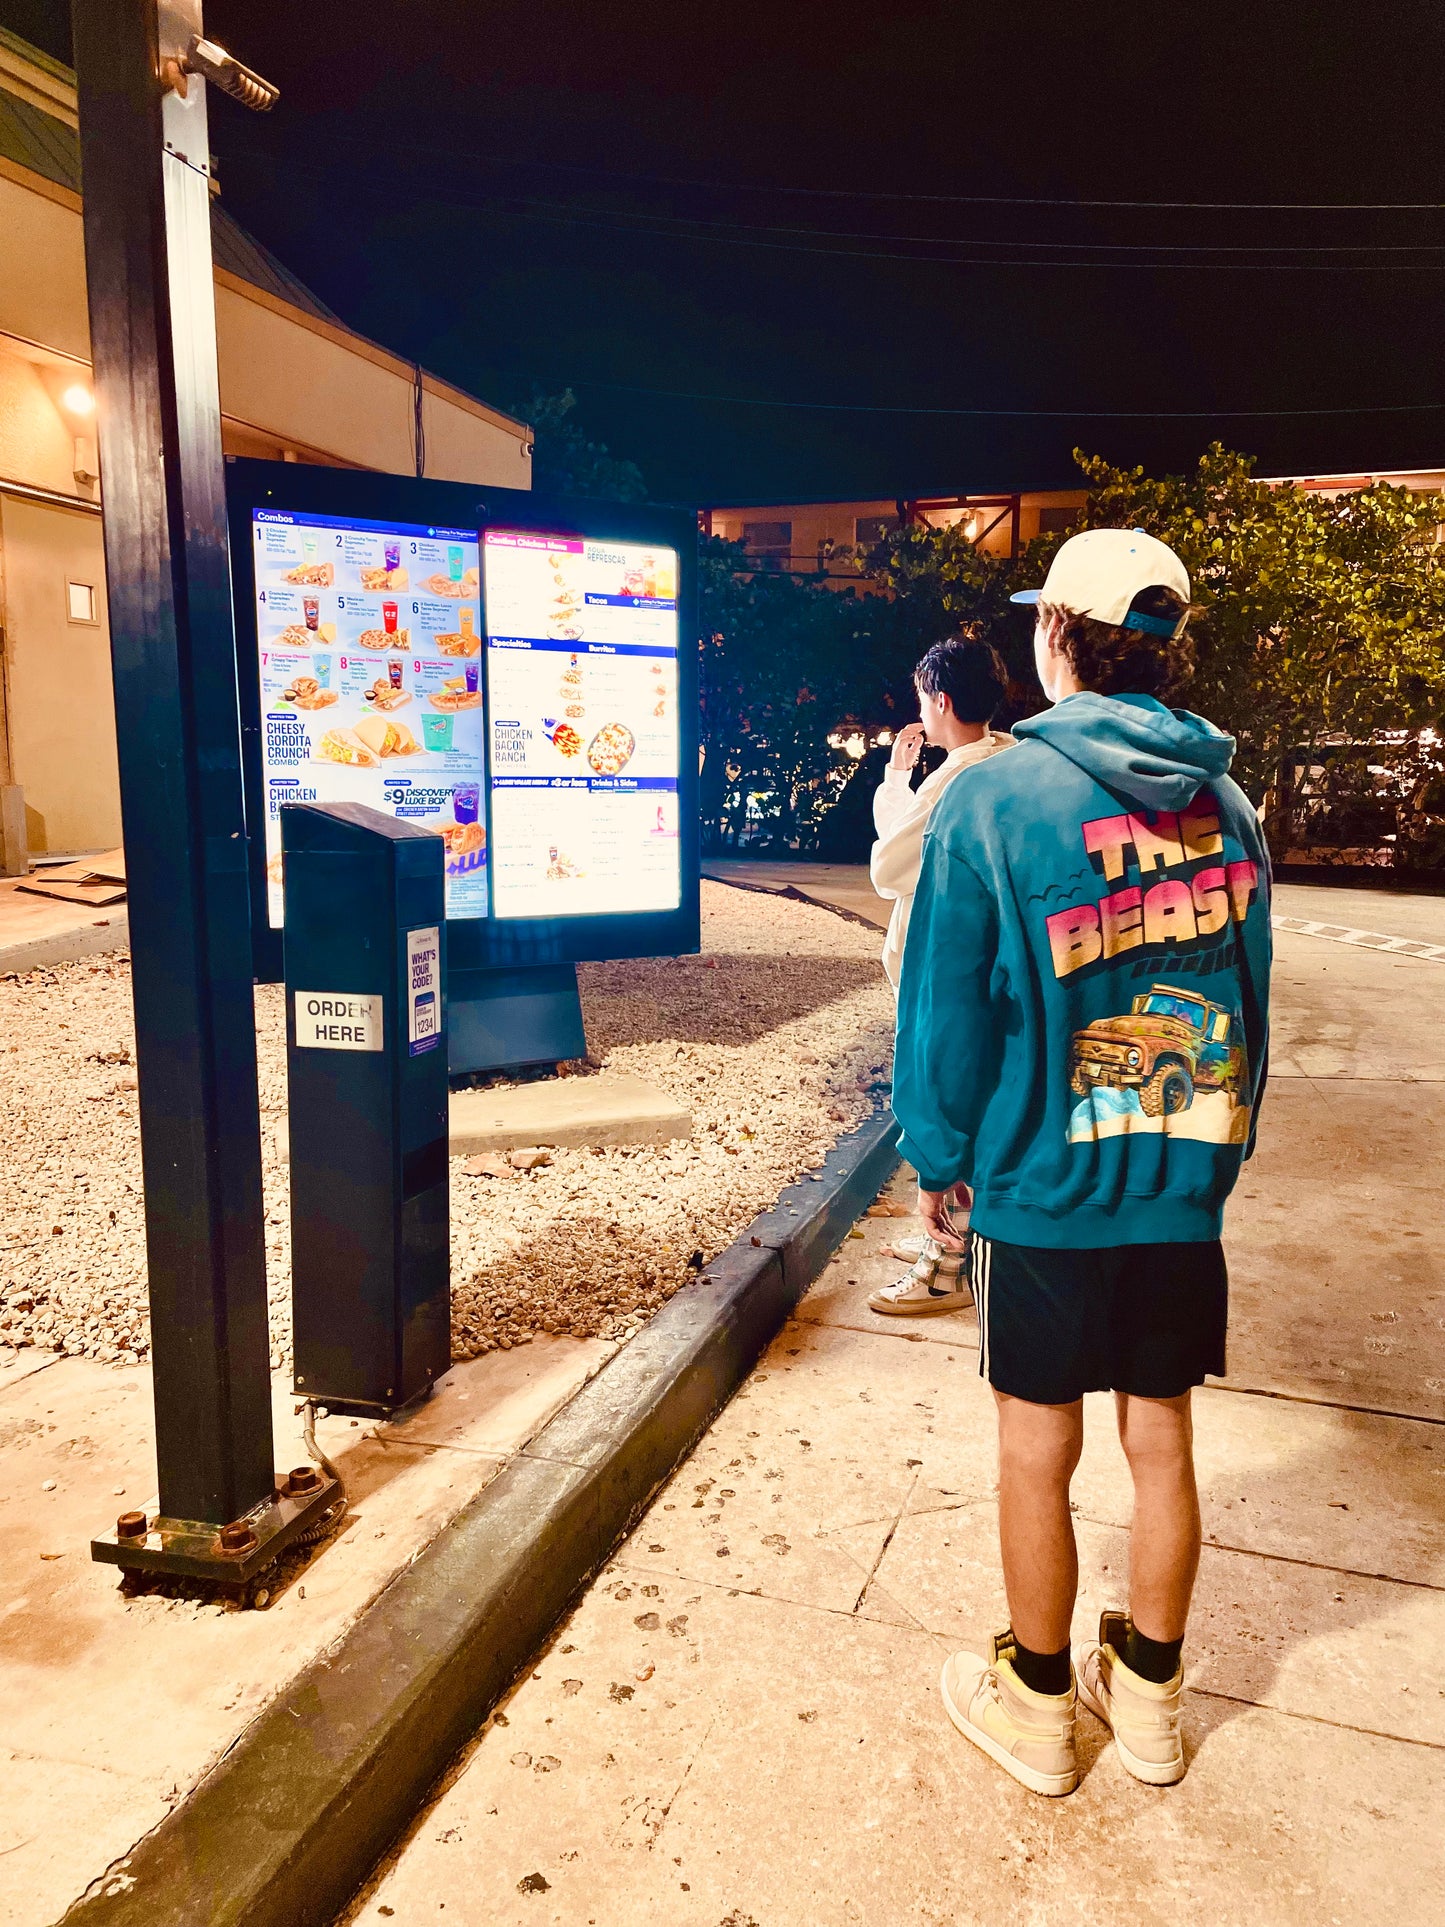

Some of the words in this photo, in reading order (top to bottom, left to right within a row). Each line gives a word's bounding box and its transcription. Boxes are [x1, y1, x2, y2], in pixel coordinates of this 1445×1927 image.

[257, 512, 294, 523] Combos
[257, 527, 262, 540] 1
[335, 535, 343, 548] 2
[410, 542, 417, 554] 3
[587, 553, 625, 565] REFRESCAS
[259, 591, 267, 603] 4
[338, 596, 345, 609] 5
[587, 595, 607, 605] Tacos
[412, 601, 419, 614] 6
[492, 638, 532, 649] Specialties
[588, 644, 616, 653] Burritos
[262, 653, 268, 665] 7
[340, 657, 347, 669] 8
[414, 660, 421, 673] 9
[267, 722, 305, 735] CHEESY
[495, 728, 533, 740] CHICKEN
[267, 735, 312, 747] GORDITA
[495, 740, 525, 751] BACON
[268, 747, 310, 759] CRUNCH
[495, 751, 526, 763] RANCH
[270, 788, 317, 801] CHICKEN
[383, 789, 404, 805] $9
[406, 788, 457, 797] DISCOVERY
[405, 797, 427, 805] LUXE
[428, 797, 447, 805] BOX
[1082, 796, 1224, 882] THE
[1045, 858, 1259, 980] BEAST
[411, 948, 436, 965] WHAT'S
[412, 962, 430, 978] YOUR
[412, 974, 433, 990] CODE?
[416, 1017, 434, 1034] 1234
[315, 1023, 366, 1043] HERE
